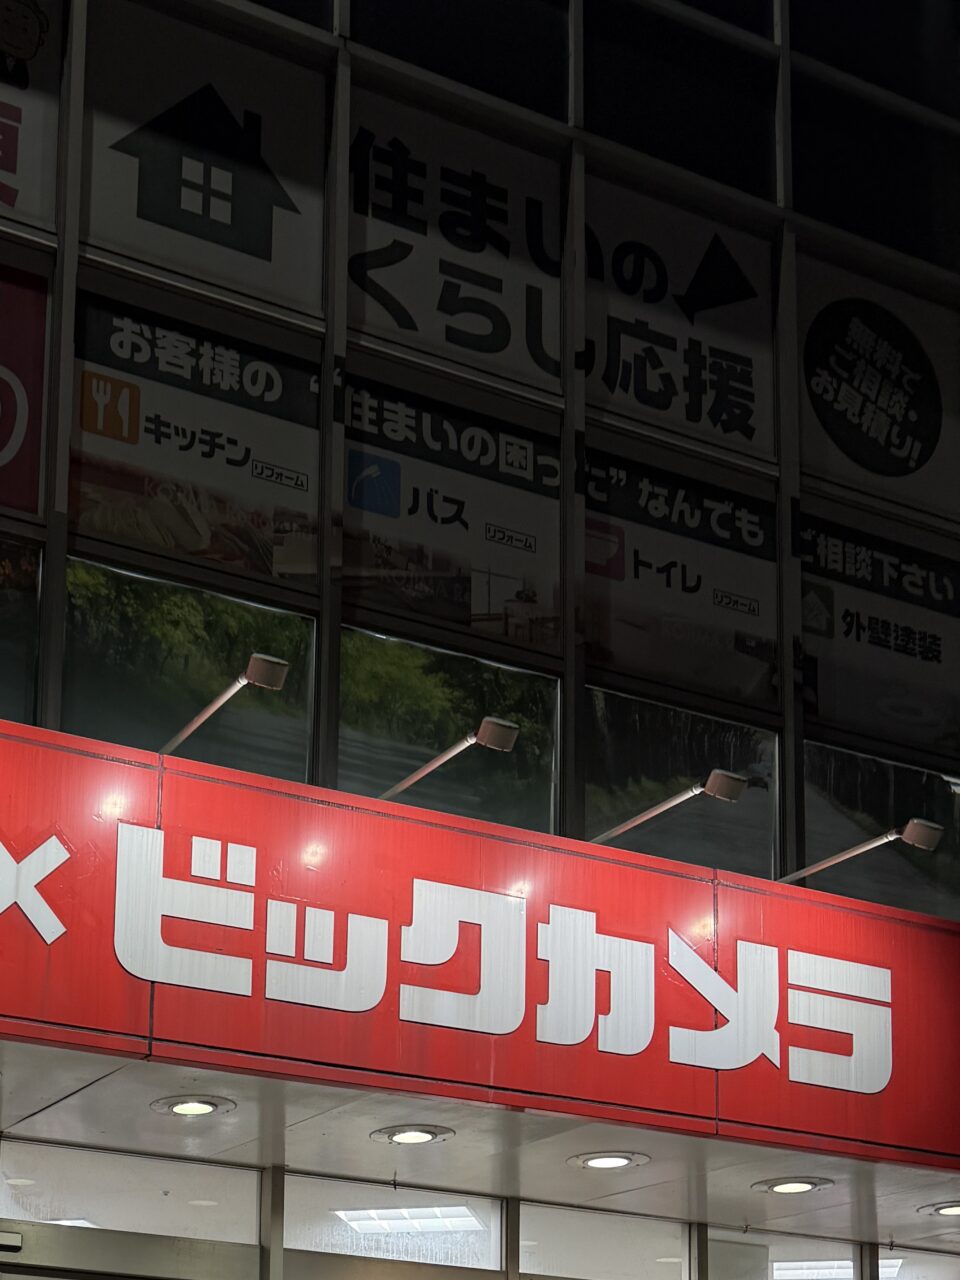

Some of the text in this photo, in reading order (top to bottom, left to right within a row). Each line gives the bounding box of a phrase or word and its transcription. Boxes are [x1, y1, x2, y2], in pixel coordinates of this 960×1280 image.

[349, 126, 669, 303] 住まいの
[348, 239, 756, 441] くらし応援
[144, 413, 251, 466] キッチン
[253, 464, 307, 489] リフォーム
[407, 486, 469, 531] バス
[633, 549, 702, 594] トイレ
[113, 818, 893, 1096] ビックカメラ
